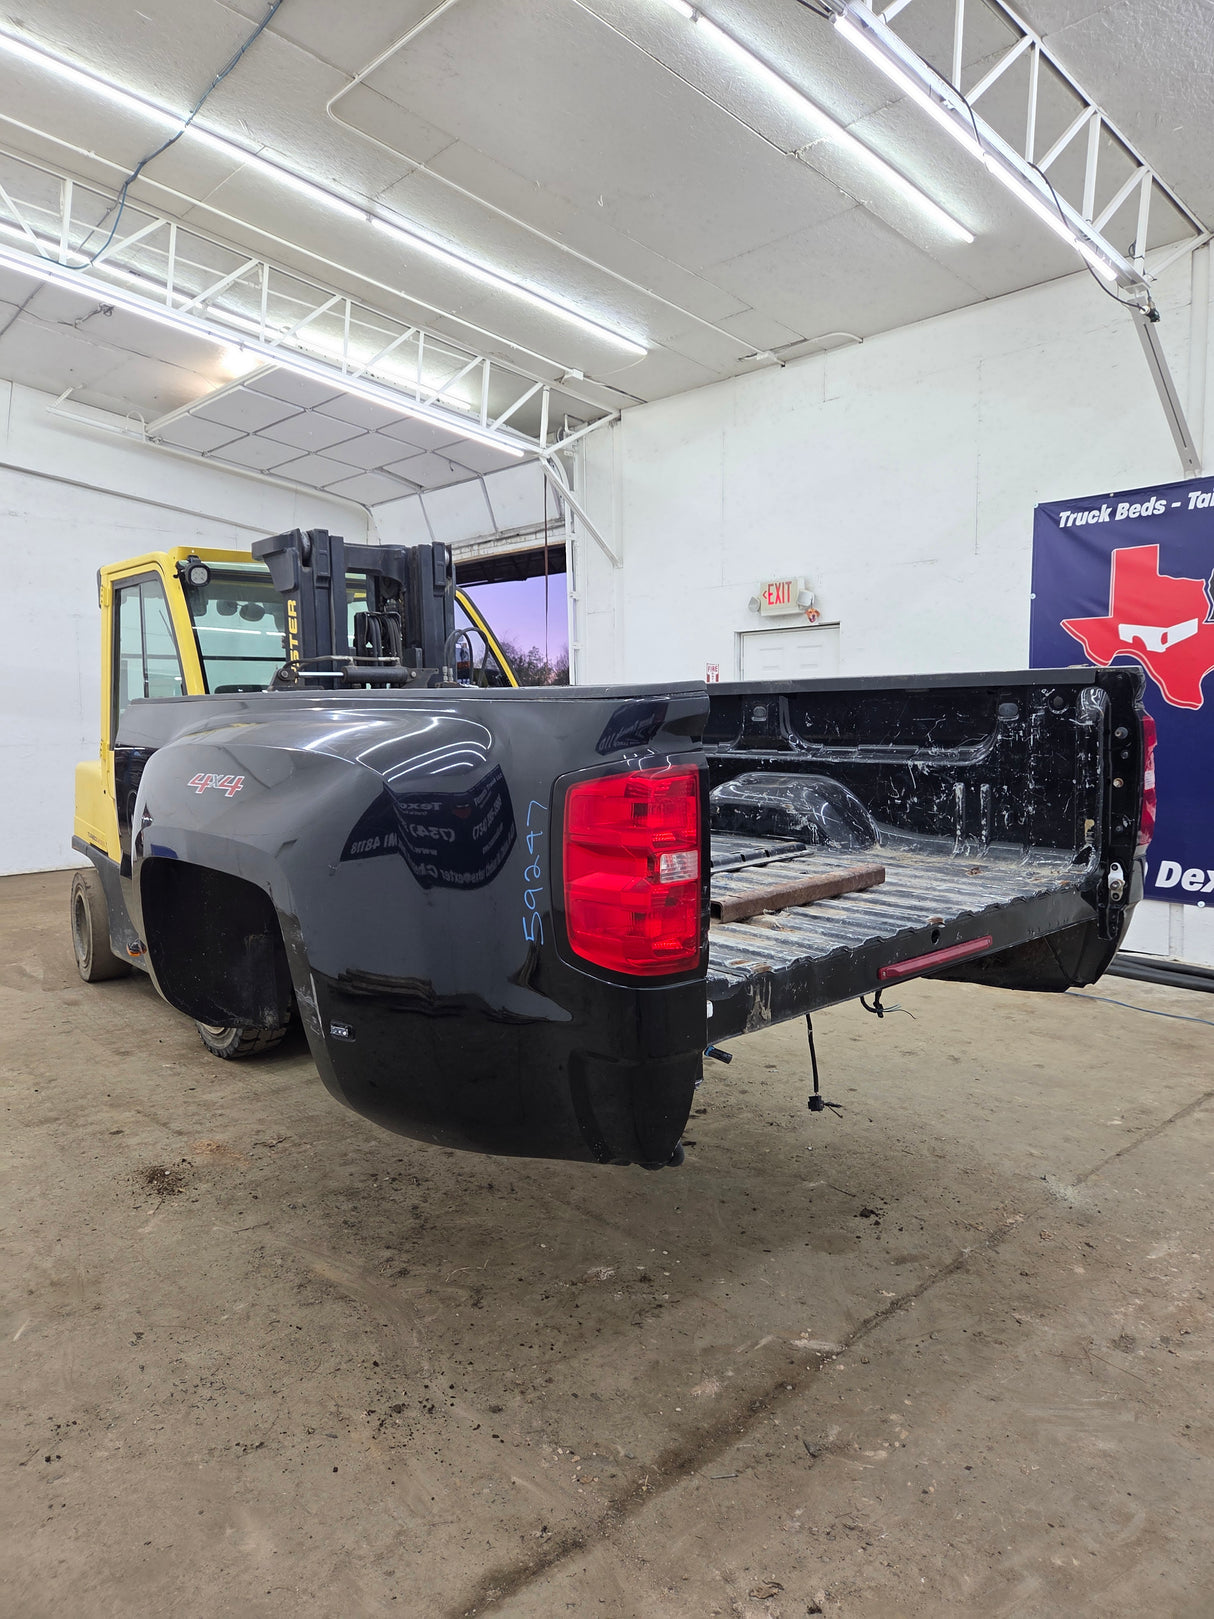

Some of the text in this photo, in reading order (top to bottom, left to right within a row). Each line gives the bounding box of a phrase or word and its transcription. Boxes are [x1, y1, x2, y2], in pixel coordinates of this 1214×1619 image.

[1059, 504, 1113, 528] Truck
[1115, 497, 1167, 520] Beds
[767, 581, 792, 605] EXIT
[287, 599, 299, 684] STER
